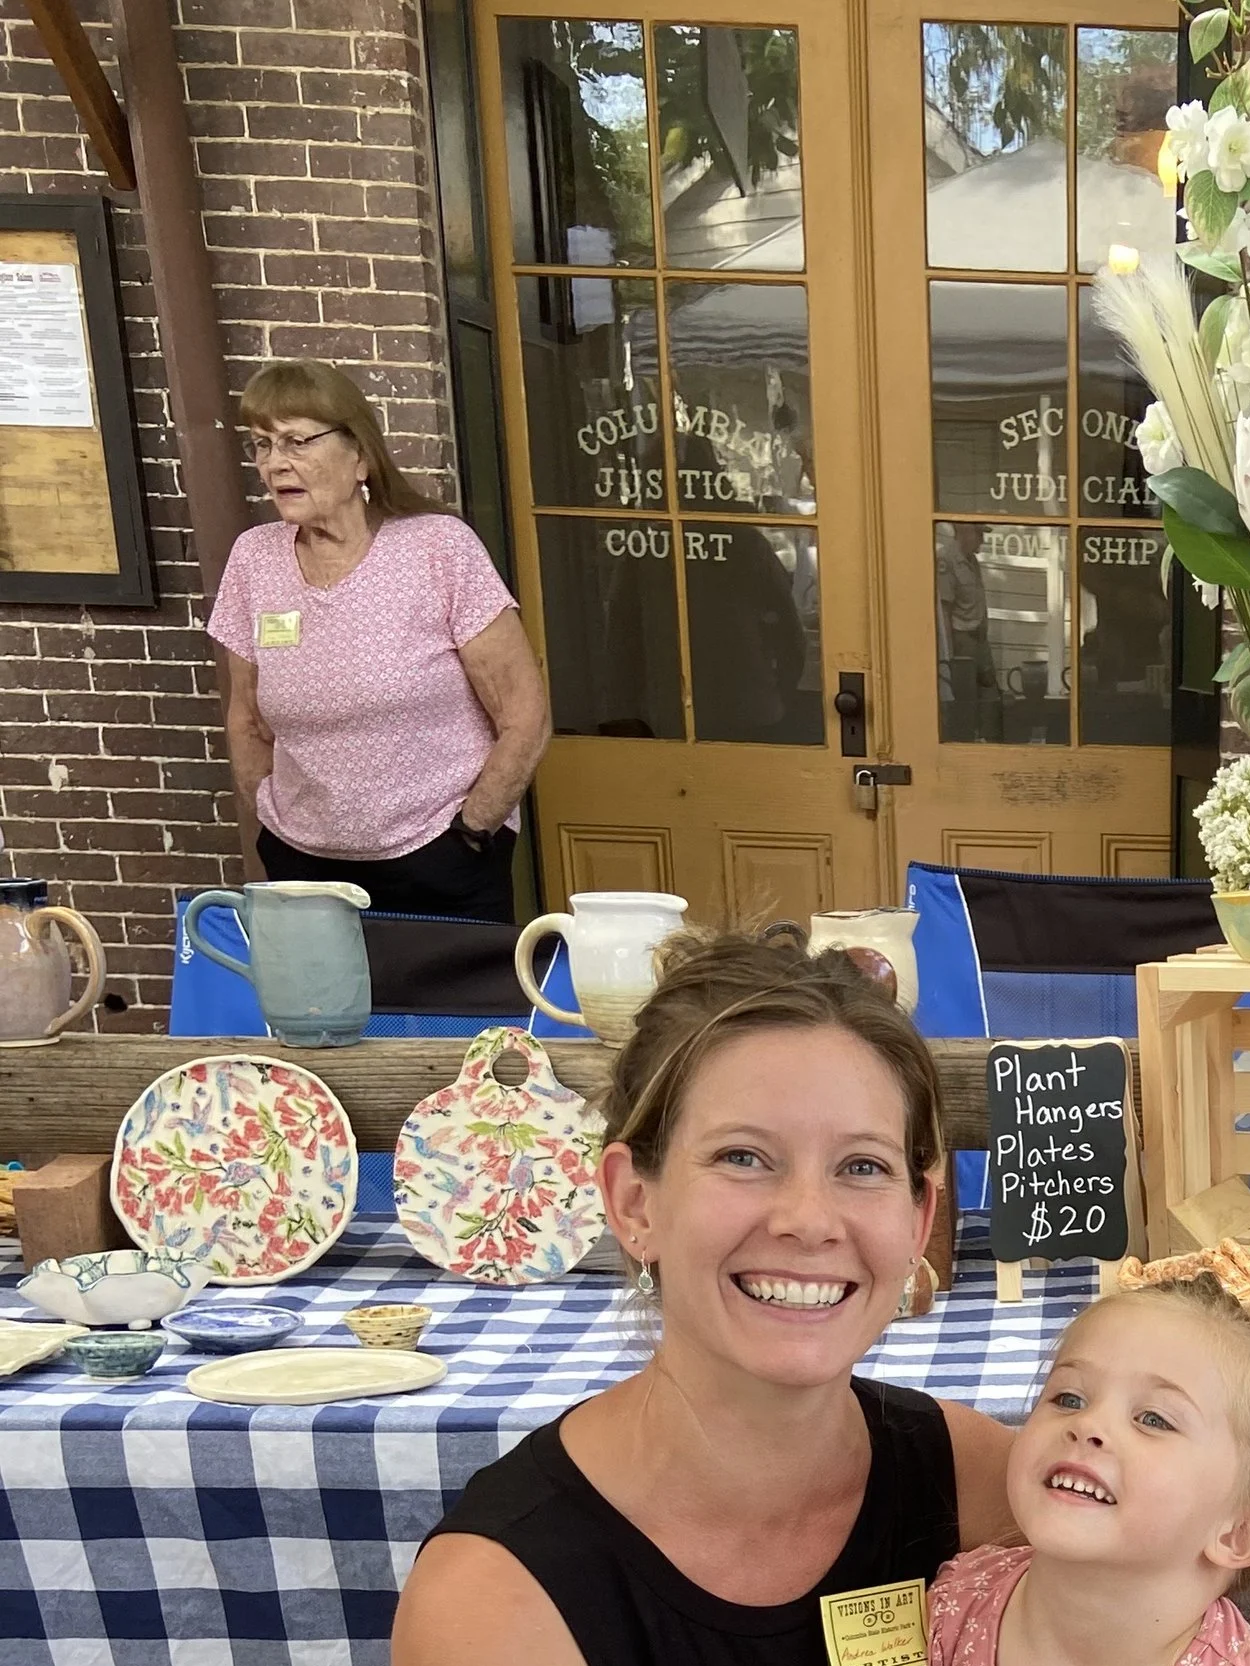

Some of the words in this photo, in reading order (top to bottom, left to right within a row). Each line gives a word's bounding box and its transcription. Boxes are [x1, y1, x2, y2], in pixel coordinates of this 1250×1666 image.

[595, 467, 755, 503] JUSTICE
[605, 527, 733, 561] COURT
[983, 532, 1158, 565] TOWNSHIP
[994, 1052, 1086, 1093] Plant
[1015, 1095, 1123, 1133] Hangers
[996, 1131, 1095, 1169] Plates
[1001, 1171, 1115, 1204] Pitchers
[1022, 1201, 1106, 1246] $20
[837, 1600, 876, 1617] VISIONS
[880, 1596, 891, 1610] IN
[895, 1592, 914, 1607] ART
